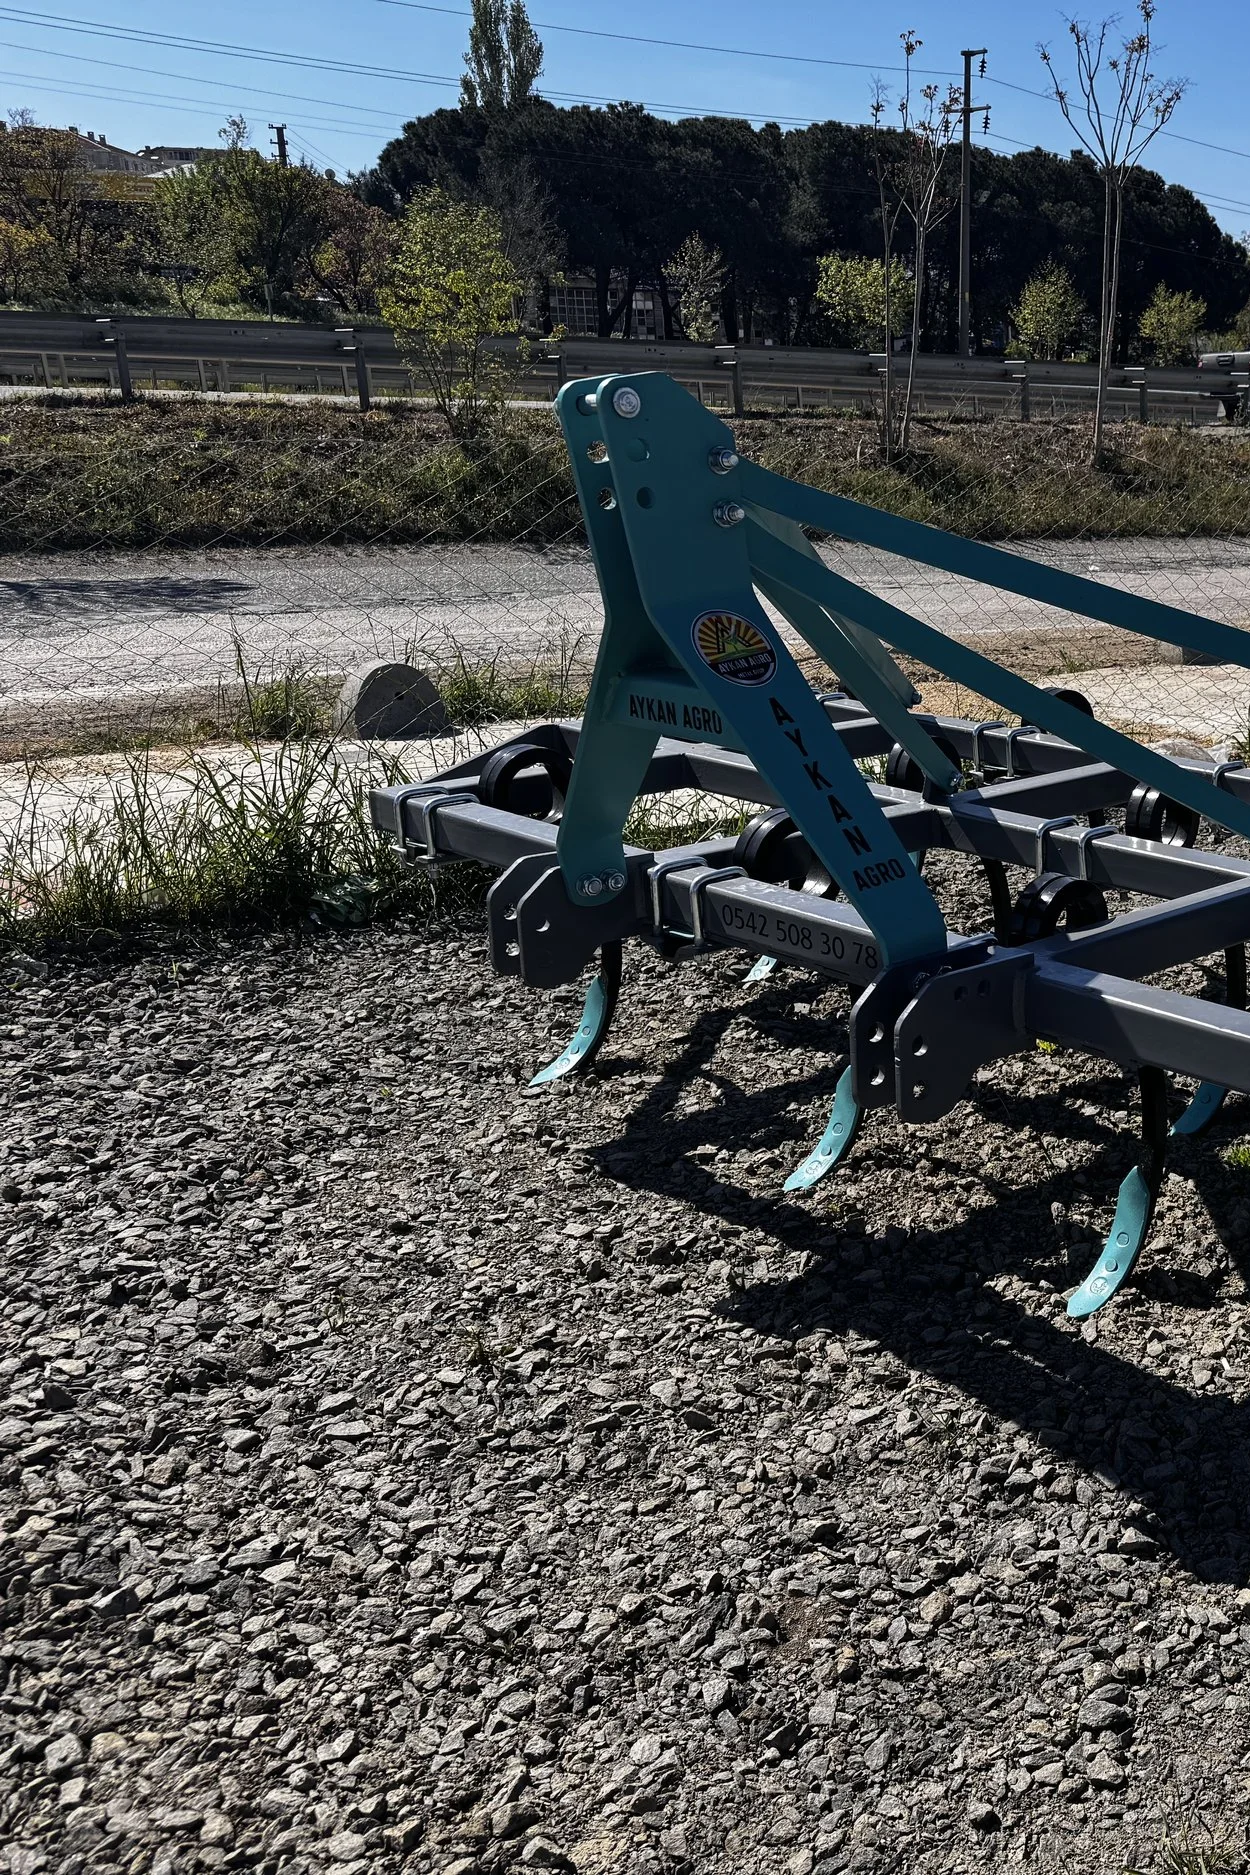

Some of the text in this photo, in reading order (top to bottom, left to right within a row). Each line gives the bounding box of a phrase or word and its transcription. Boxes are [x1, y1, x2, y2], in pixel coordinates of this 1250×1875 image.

[718, 653, 772, 674] AYKAN AGRO
[629, 694, 723, 735] AYKAN AGRO
[769, 697, 906, 892] AYKAN AGRO
[722, 904, 878, 969] 0542 508 30 78
